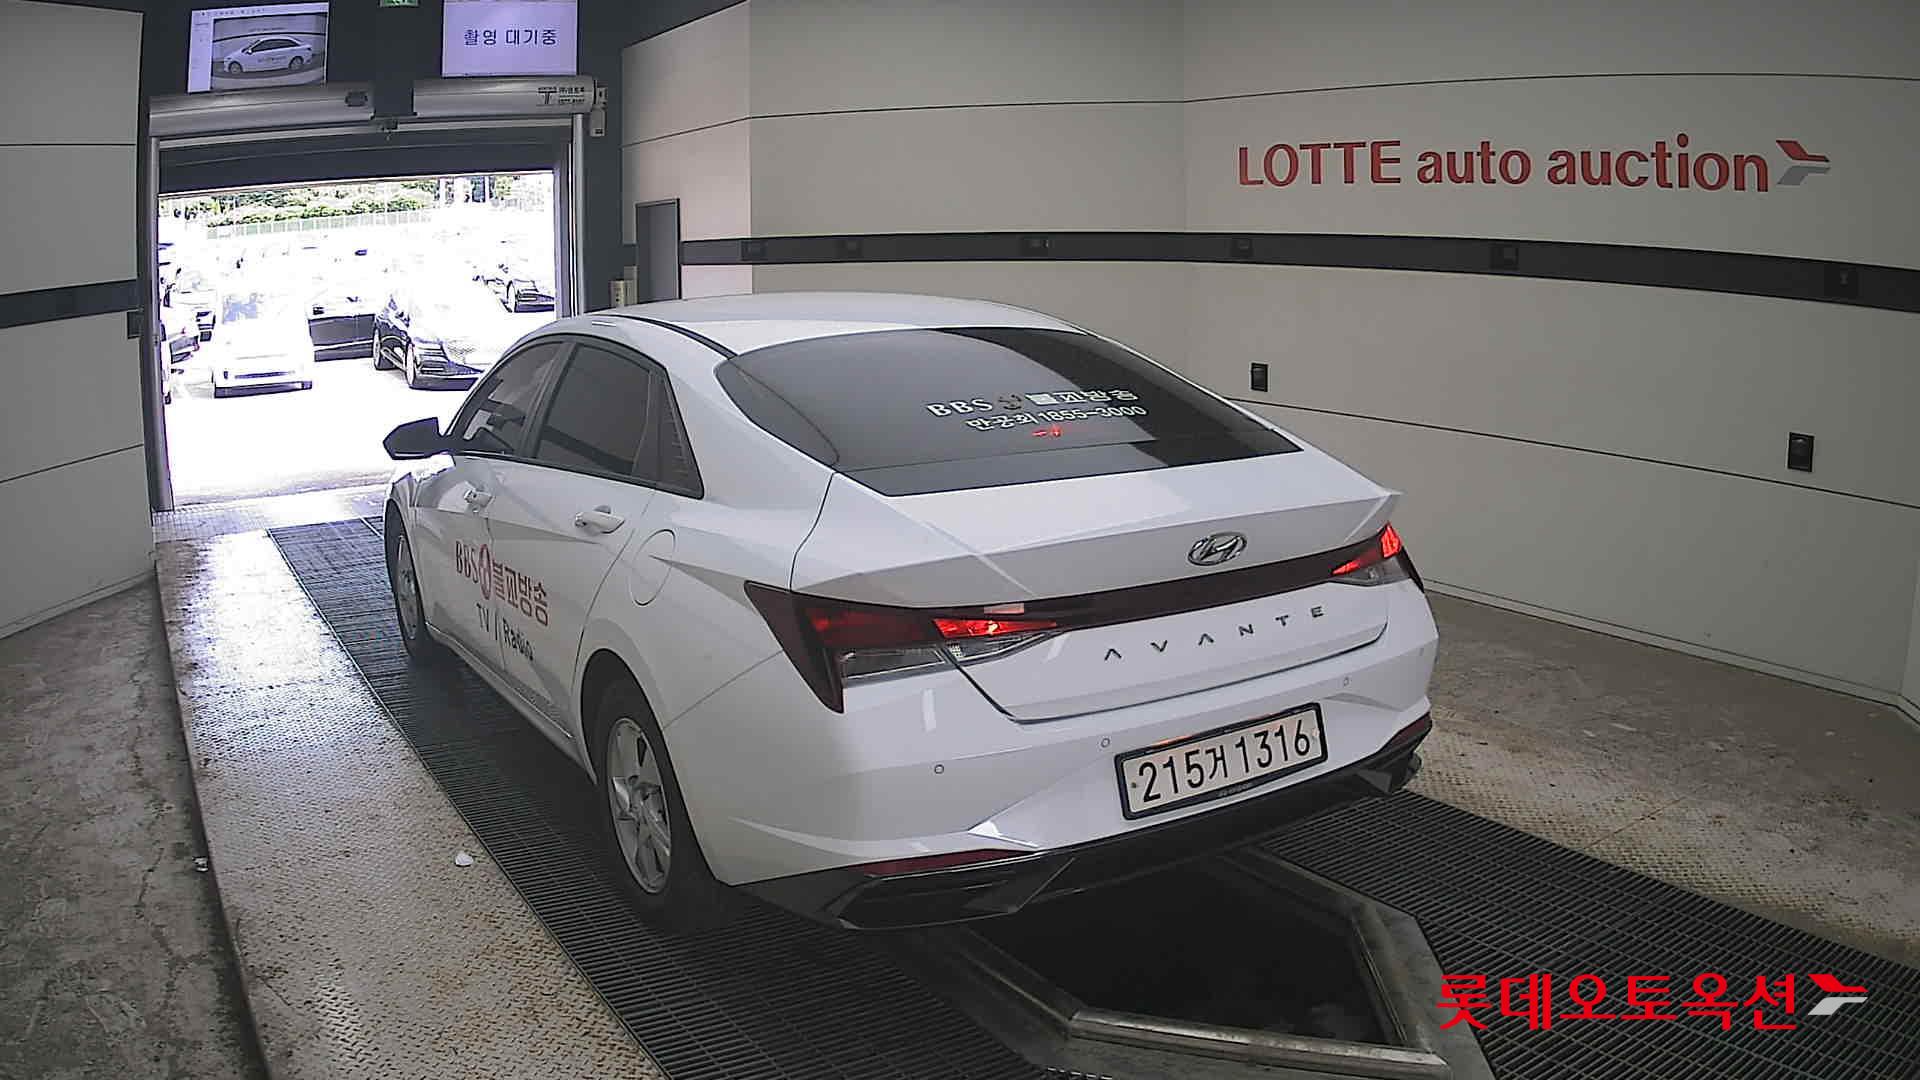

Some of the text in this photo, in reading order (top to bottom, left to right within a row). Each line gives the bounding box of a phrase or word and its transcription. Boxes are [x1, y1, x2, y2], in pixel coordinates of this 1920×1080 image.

[505, 29, 558, 46] 대기중
[1239, 133, 1769, 193] LOTTE auto auction
[927, 399, 993, 417] BBS
[1039, 406, 1147, 422] 1855-3000
[455, 540, 549, 626] BBS 불교방송
[1104, 606, 1325, 661] AVANTE
[1235, 719, 1311, 774] 1316
